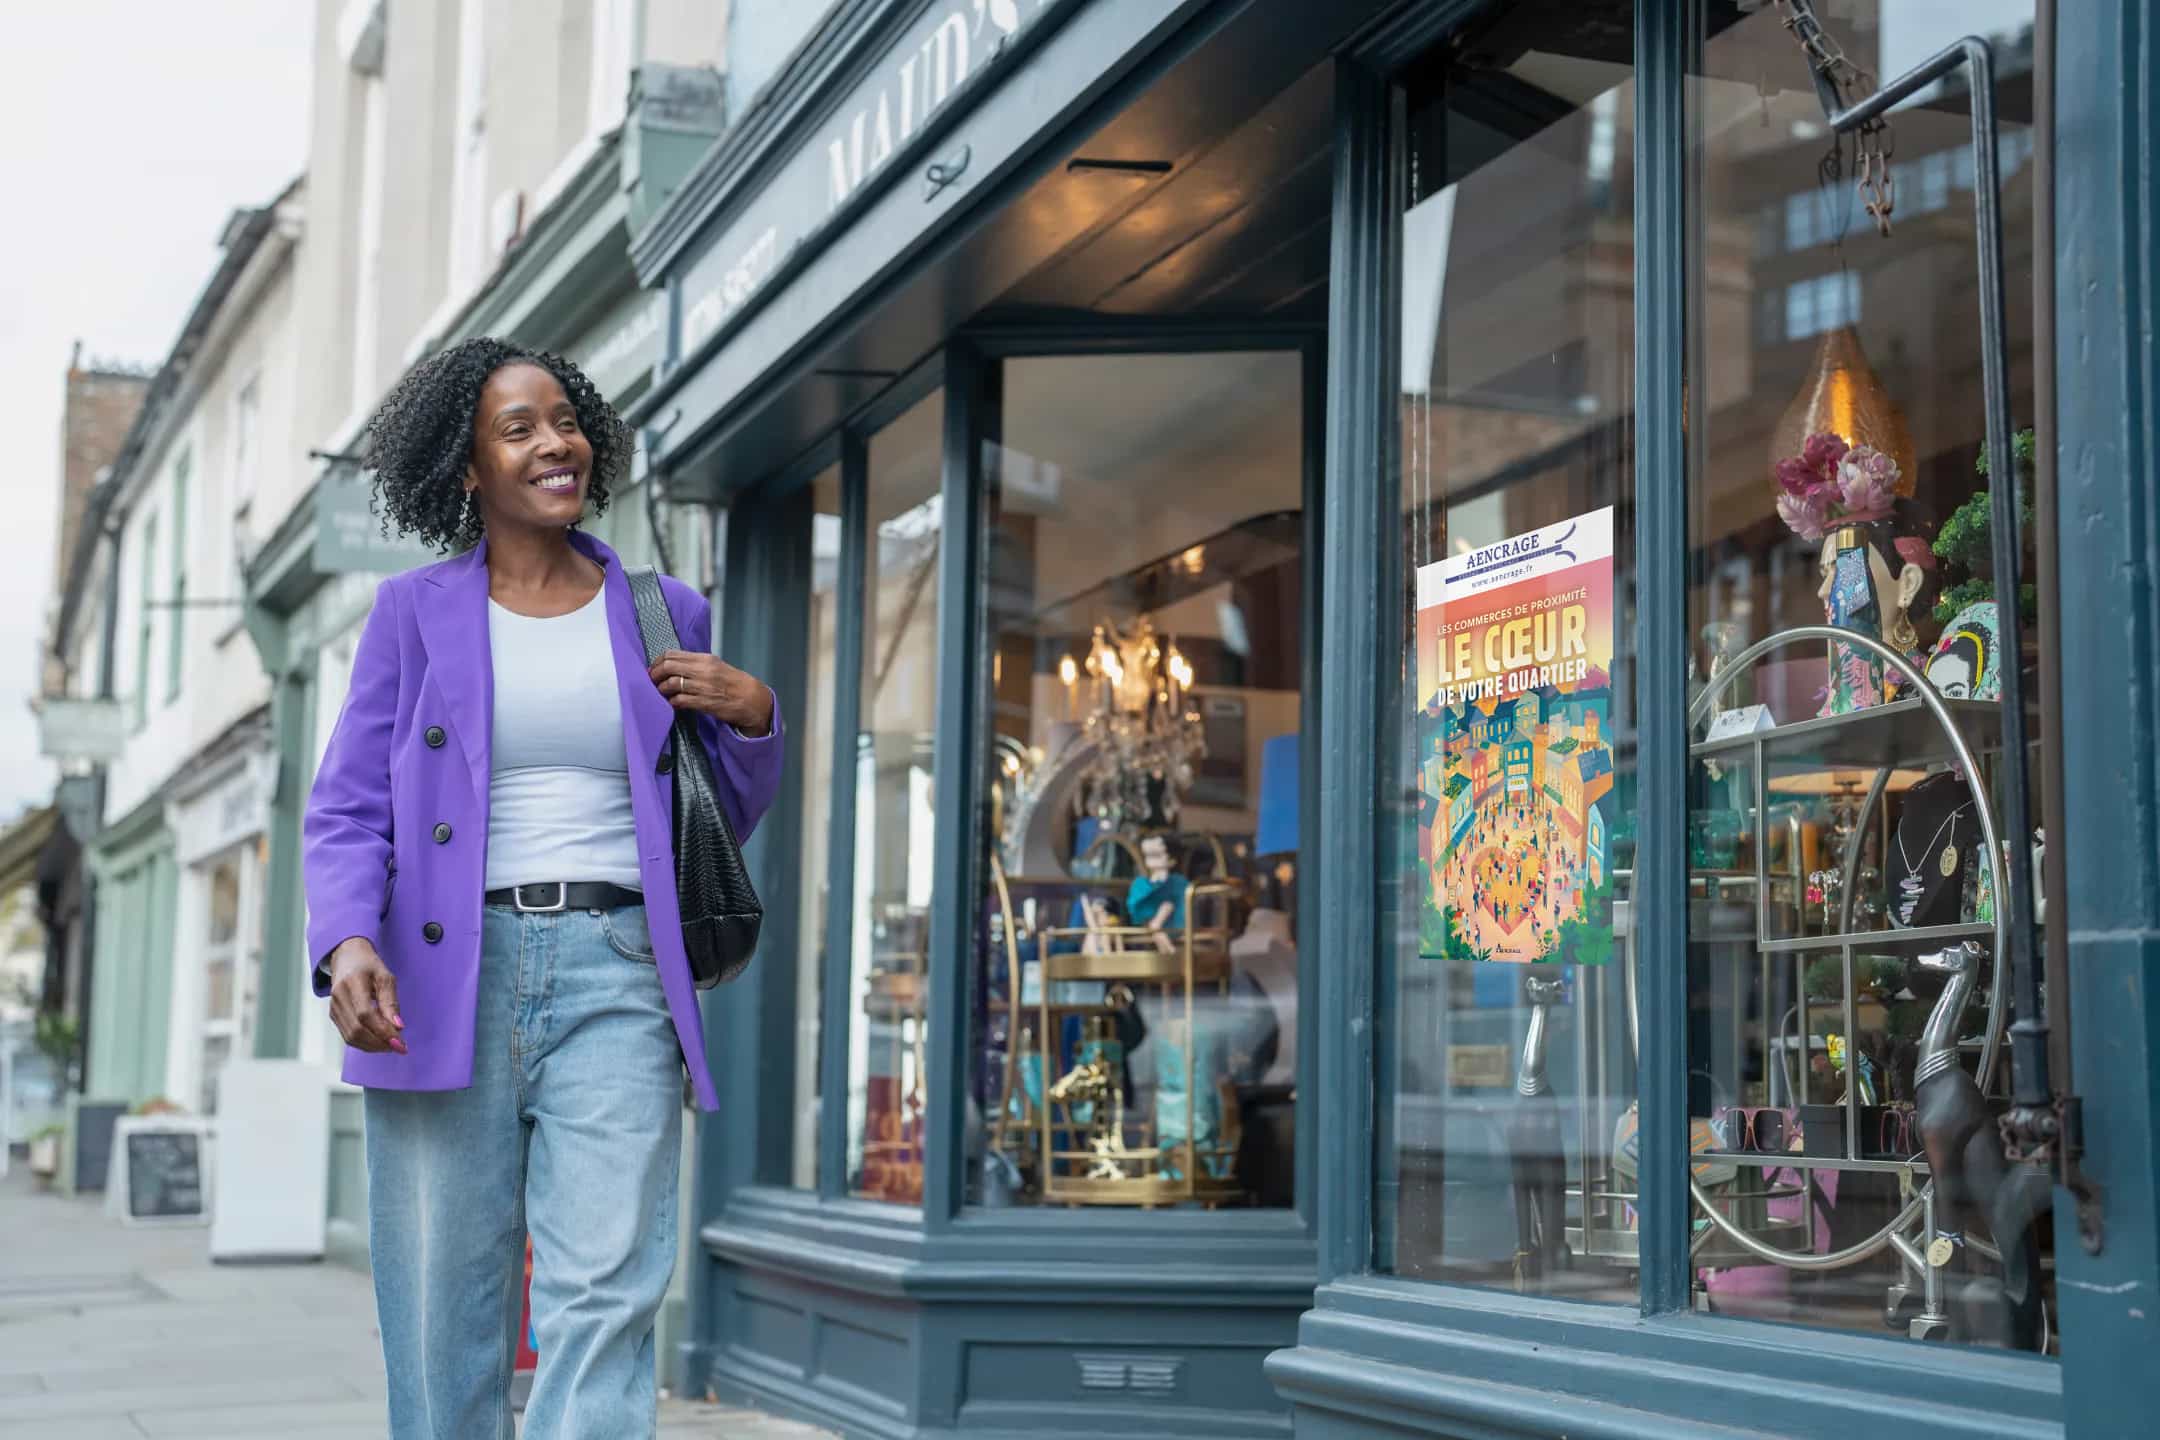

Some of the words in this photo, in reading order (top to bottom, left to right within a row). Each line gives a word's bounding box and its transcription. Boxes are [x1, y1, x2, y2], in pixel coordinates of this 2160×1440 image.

[1466, 534, 1540, 570] AENCRAGE
[1437, 624, 1452, 636] LES
[1454, 607, 1512, 630] COMMERCES
[1515, 603, 1528, 616] DE
[1530, 586, 1588, 611] PROXIMITÉ
[1438, 632, 1472, 684] LE
[1484, 604, 1587, 673] CŒUR
[1438, 685, 1455, 707] DE
[1458, 675, 1504, 701] VOTRE
[1508, 658, 1587, 693] QUARTIER
